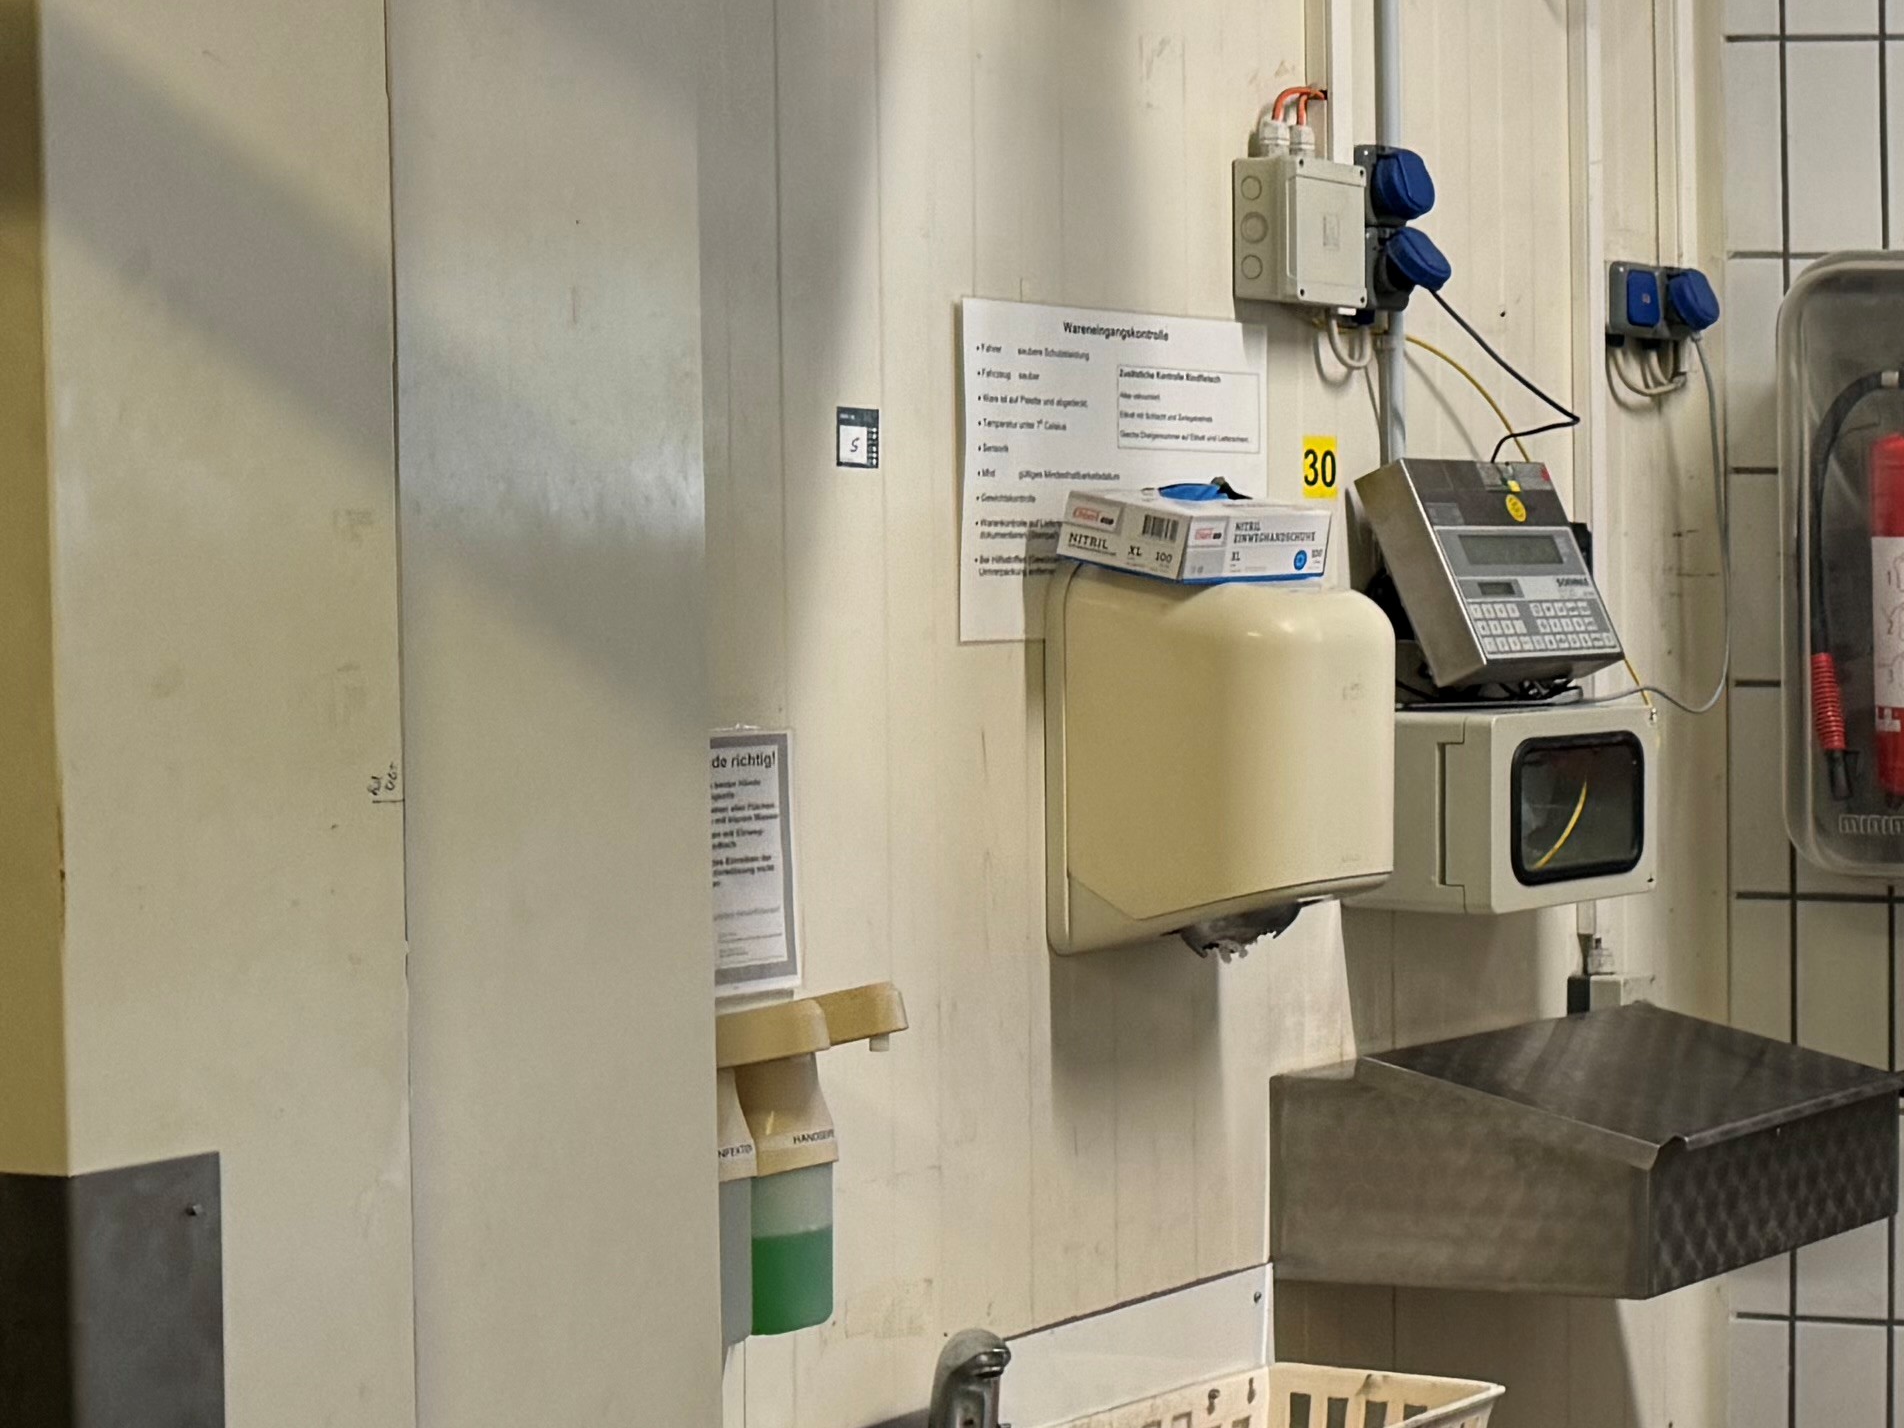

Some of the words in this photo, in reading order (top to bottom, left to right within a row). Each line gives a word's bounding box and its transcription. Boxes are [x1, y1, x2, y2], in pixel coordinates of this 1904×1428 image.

[1063, 322, 1169, 342] Wareneingangskontrolle
[1303, 448, 1337, 488] 30
[1068, 532, 1108, 550] NITRIL
[1127, 545, 1142, 557] XL
[1155, 551, 1173, 564] 100
[731, 751, 776, 769] richtig!
